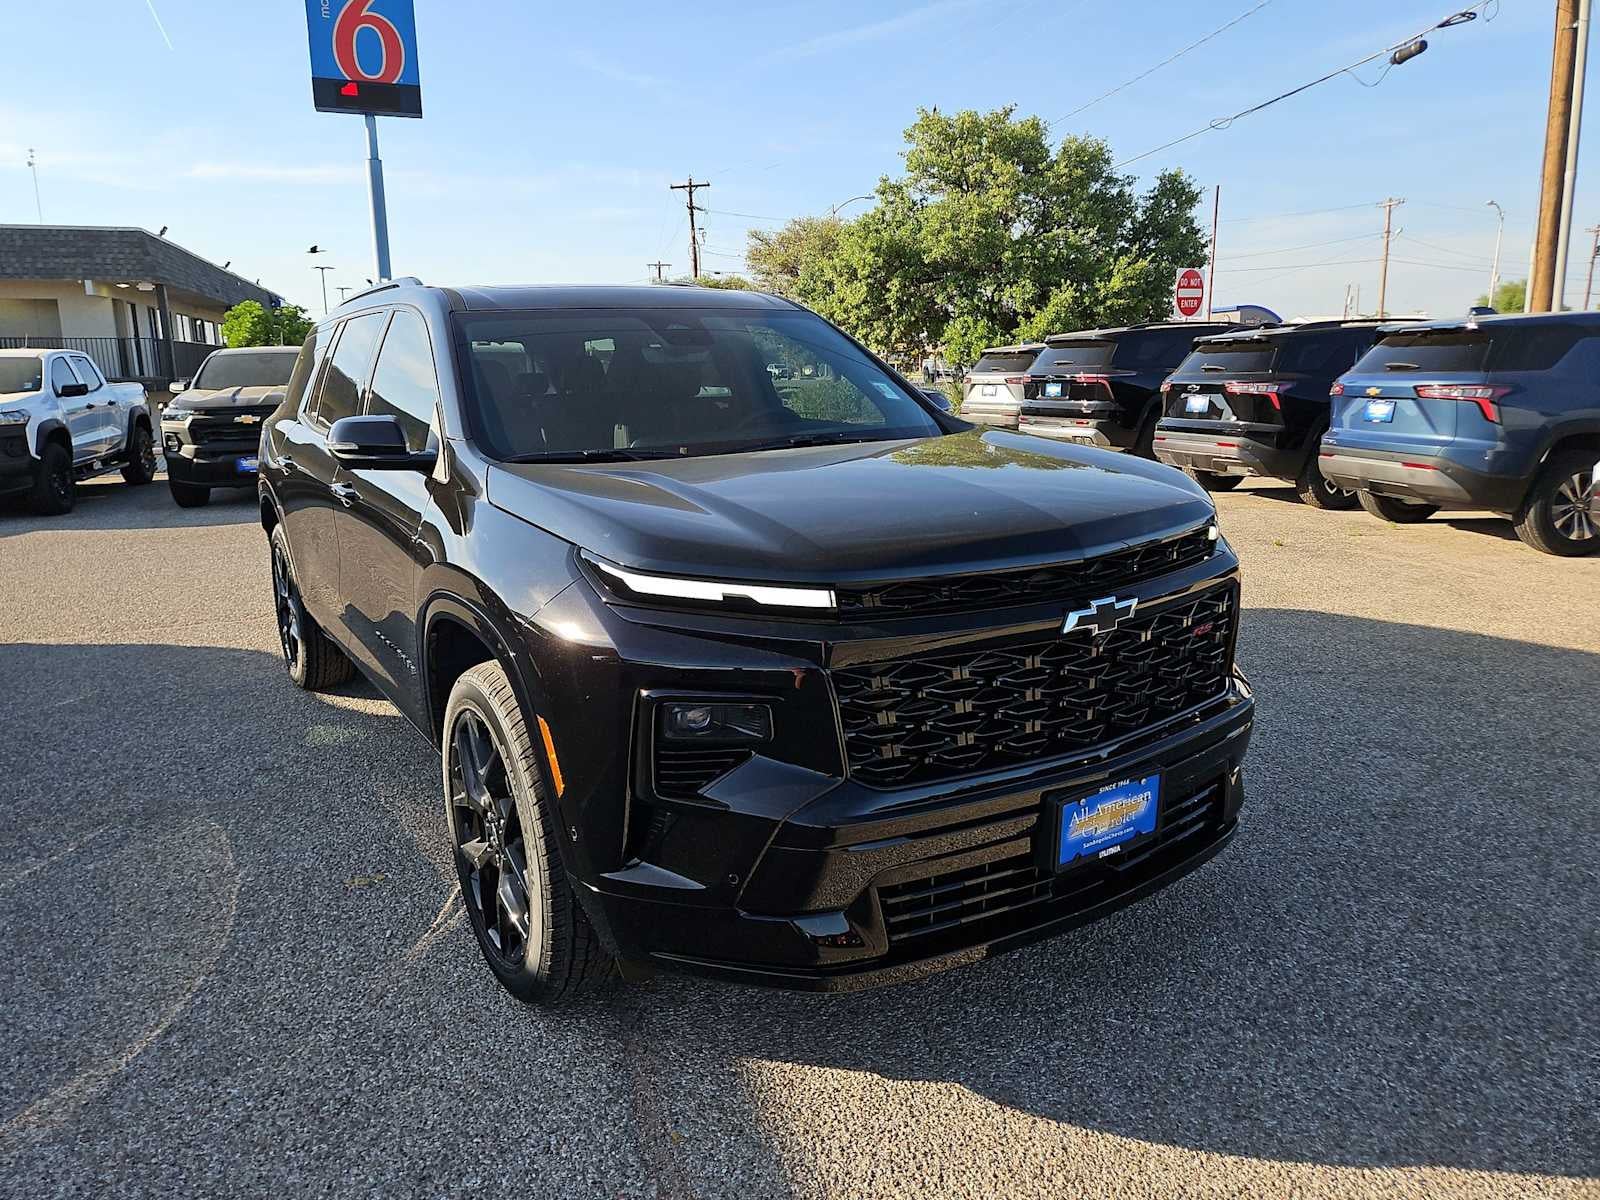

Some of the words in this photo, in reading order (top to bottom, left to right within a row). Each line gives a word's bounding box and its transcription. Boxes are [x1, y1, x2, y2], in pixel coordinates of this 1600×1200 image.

[332, 0, 406, 83] 6
[1181, 279, 1188, 287] DO
[1190, 279, 1201, 287] NOT
[1181, 300, 1198, 308] ENTER
[1099, 782, 1117, 794] SINCE
[1069, 807, 1089, 827] All
[1096, 791, 1151, 815] American
[1082, 809, 1136, 837] Chevrolet
